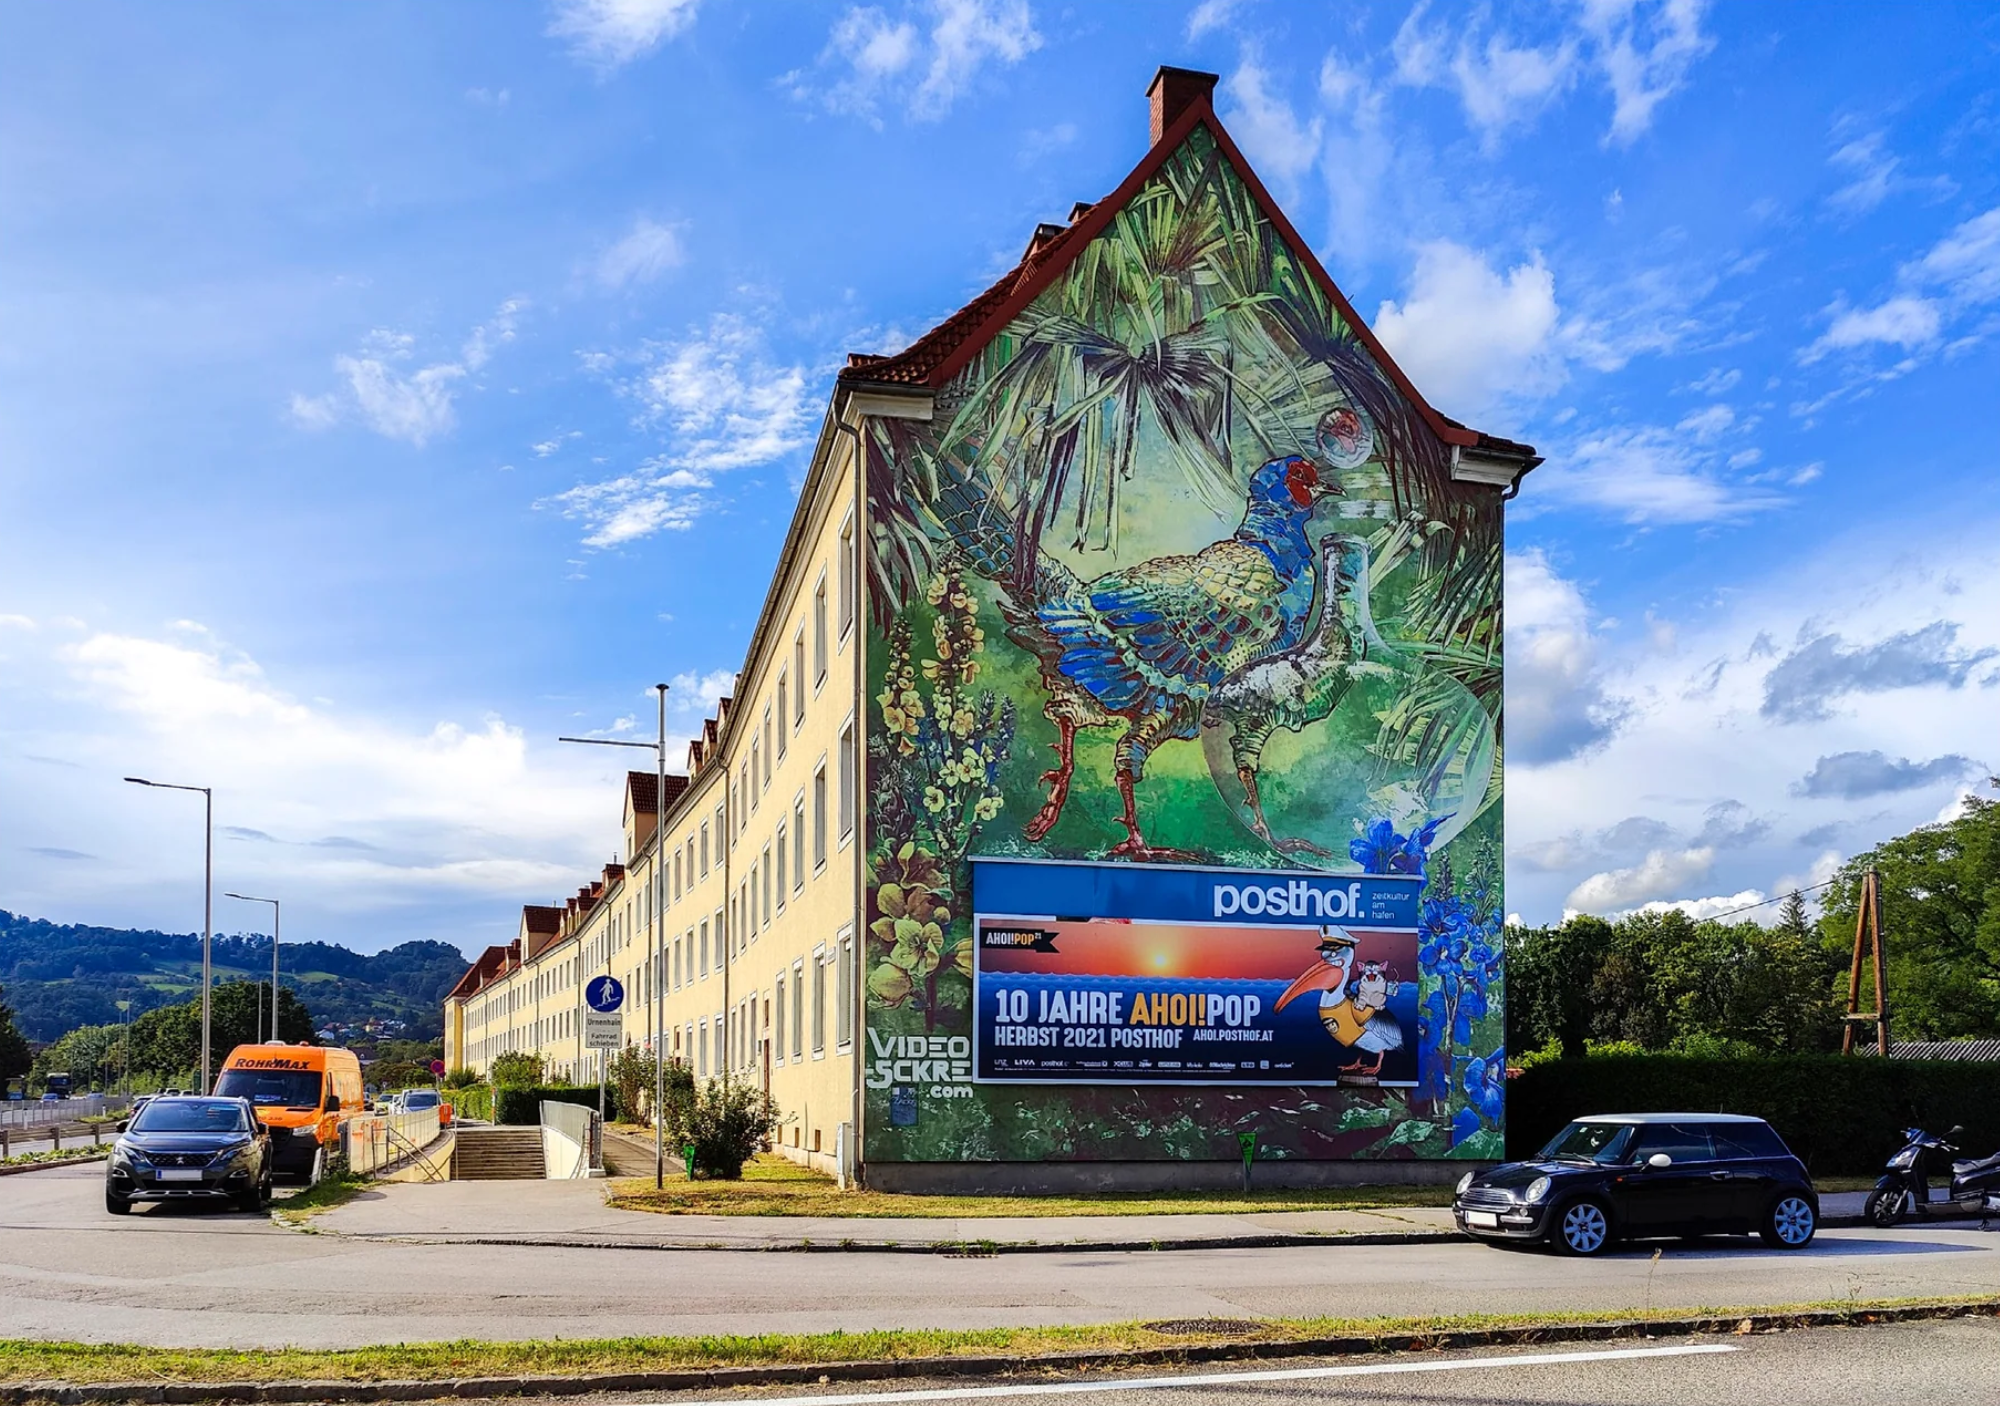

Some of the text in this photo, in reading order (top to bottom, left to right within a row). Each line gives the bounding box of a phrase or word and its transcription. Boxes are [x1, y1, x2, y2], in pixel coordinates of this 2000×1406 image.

[1214, 880, 1365, 918] posthof.
[1372, 892, 1410, 901] zeitkultur
[1372, 911, 1395, 920] hafen
[995, 988, 1261, 1027] 10 JAHRE AHOI!POP
[866, 1026, 970, 1059] VIDEO
[994, 1026, 1184, 1049] HERBST 2021 POSTHOF
[1193, 1029, 1274, 1042] AHOI.POSTHOF.AT
